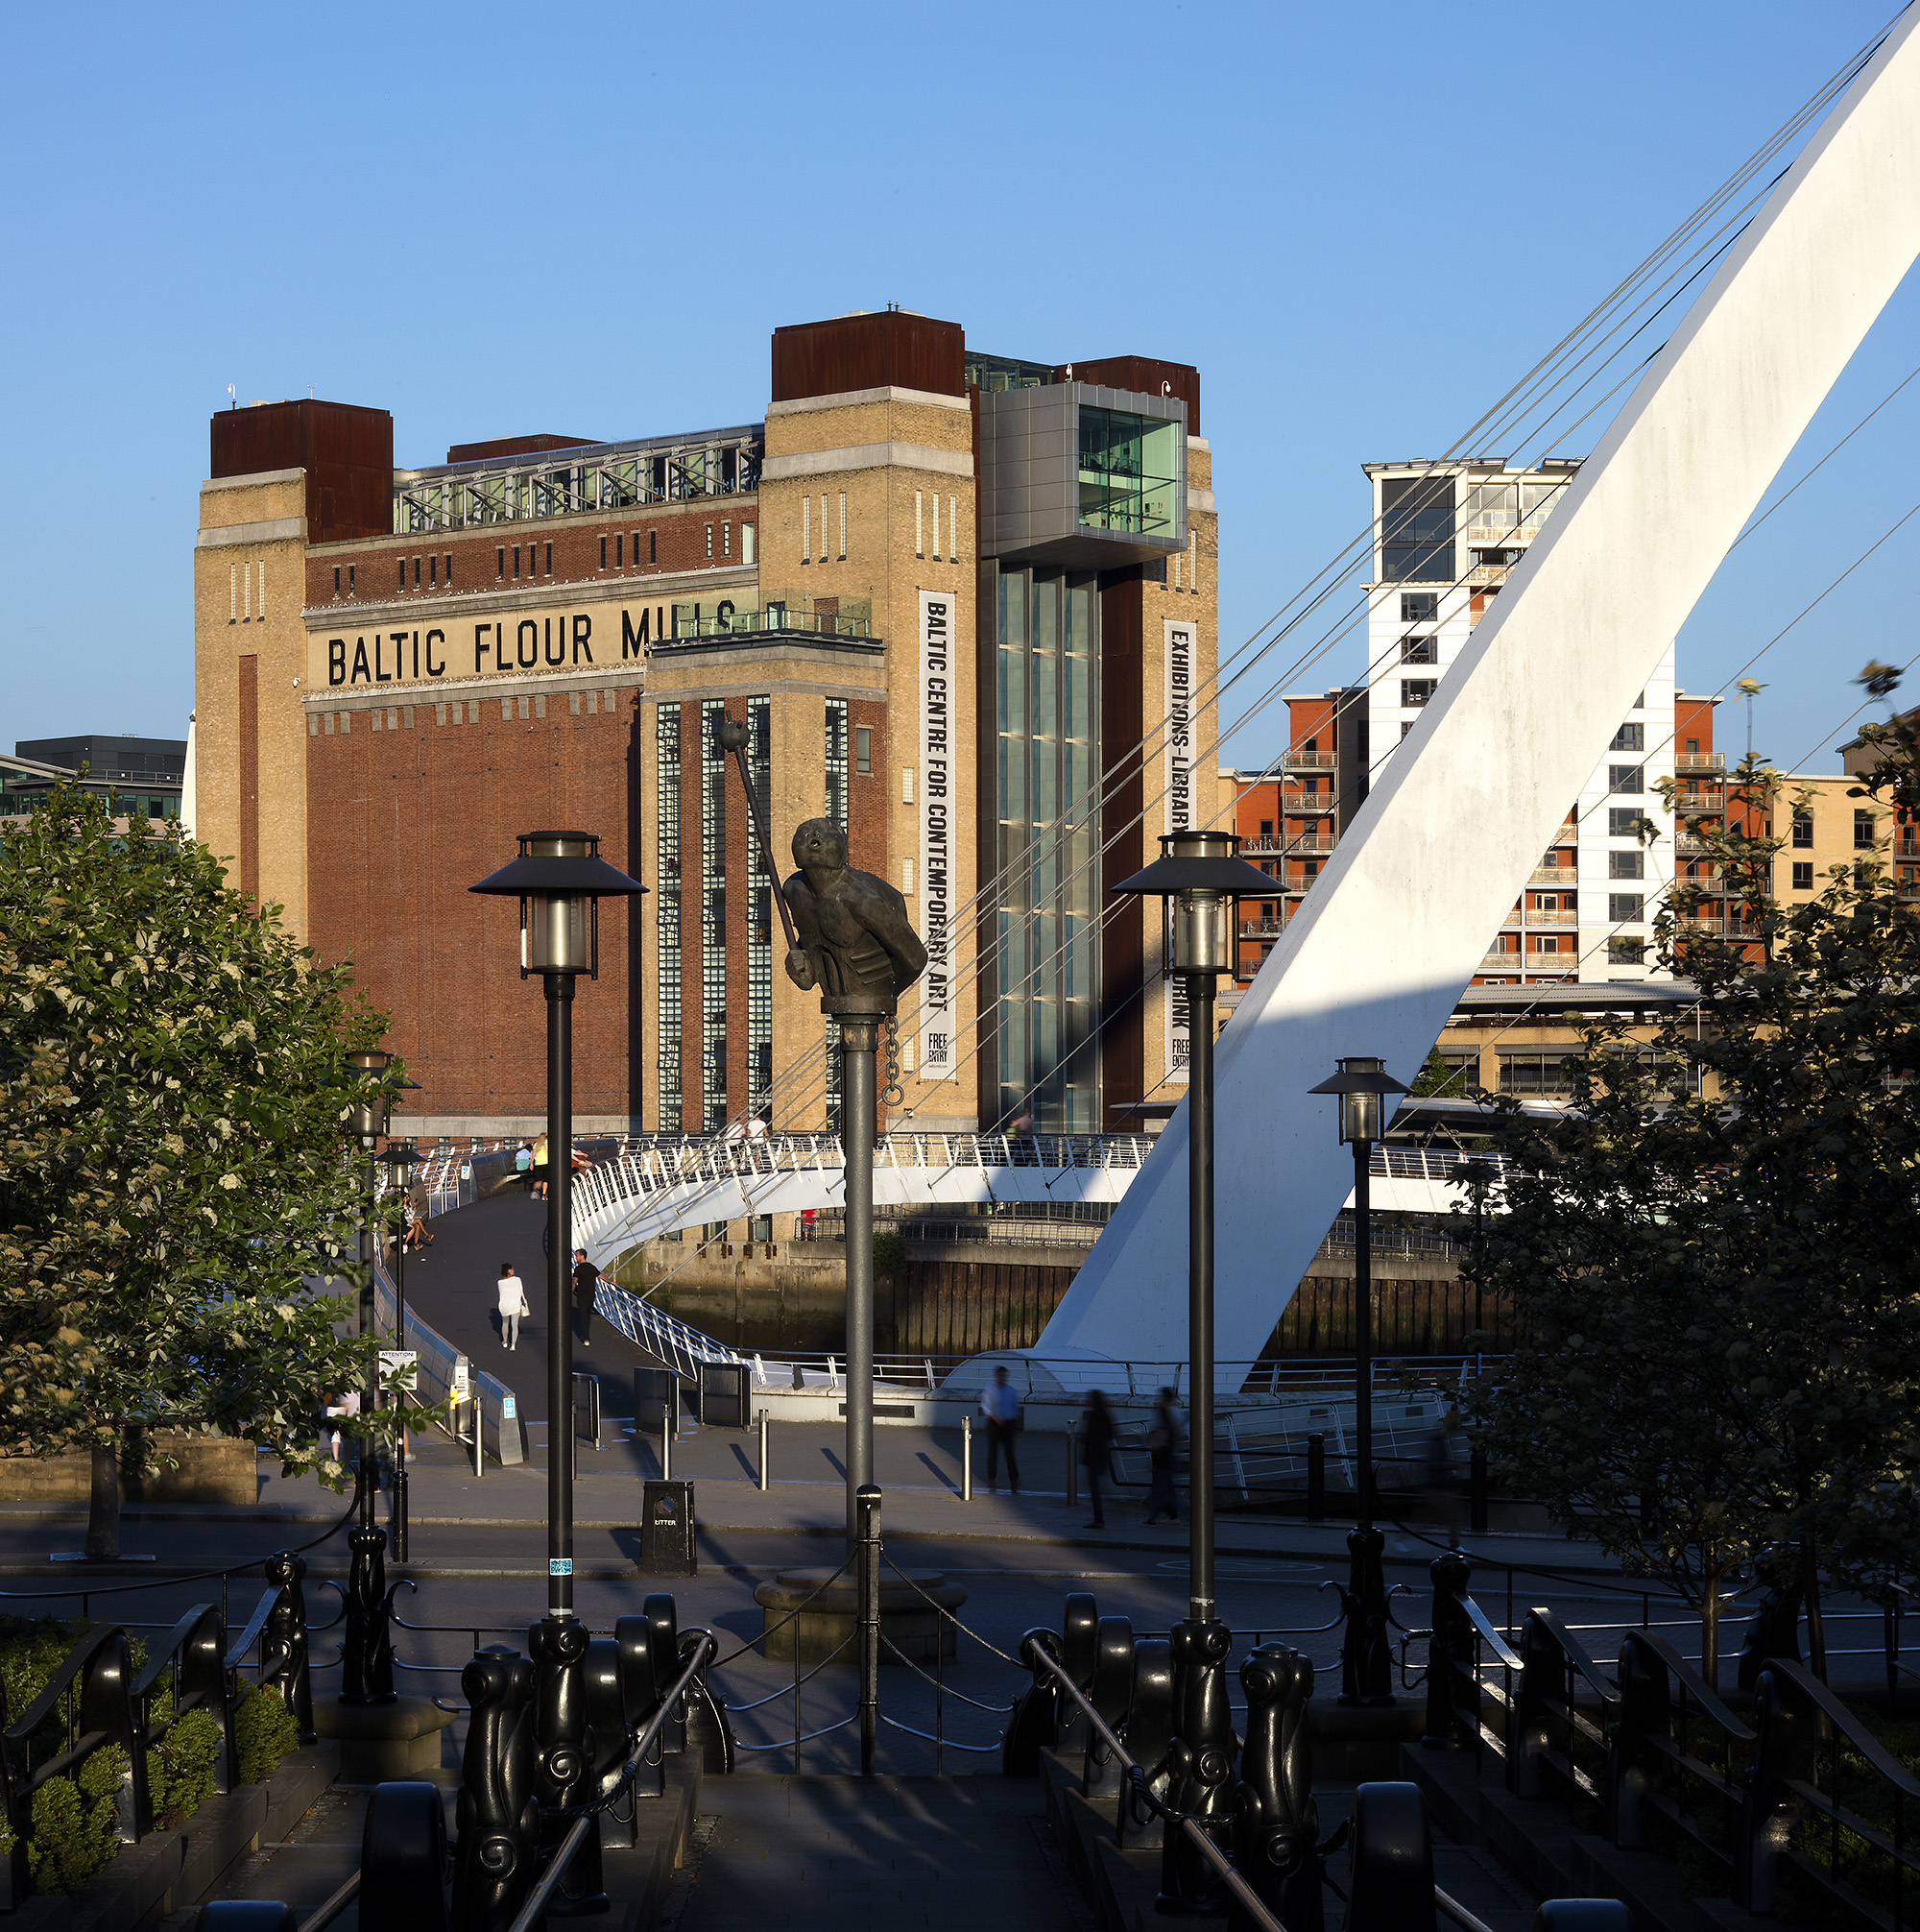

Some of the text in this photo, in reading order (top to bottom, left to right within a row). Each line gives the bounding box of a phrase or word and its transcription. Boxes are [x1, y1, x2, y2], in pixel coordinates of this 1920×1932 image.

[328, 629, 446, 686] BALTIC
[475, 614, 593, 672] FLOUR
[927, 601, 948, 1012] BALTIC CENTRE FOR CONTEMPORARY ART
[928, 1033, 948, 1049] FREE
[1172, 1038, 1190, 1054] FREE
[928, 1050, 948, 1062] ENTRY
